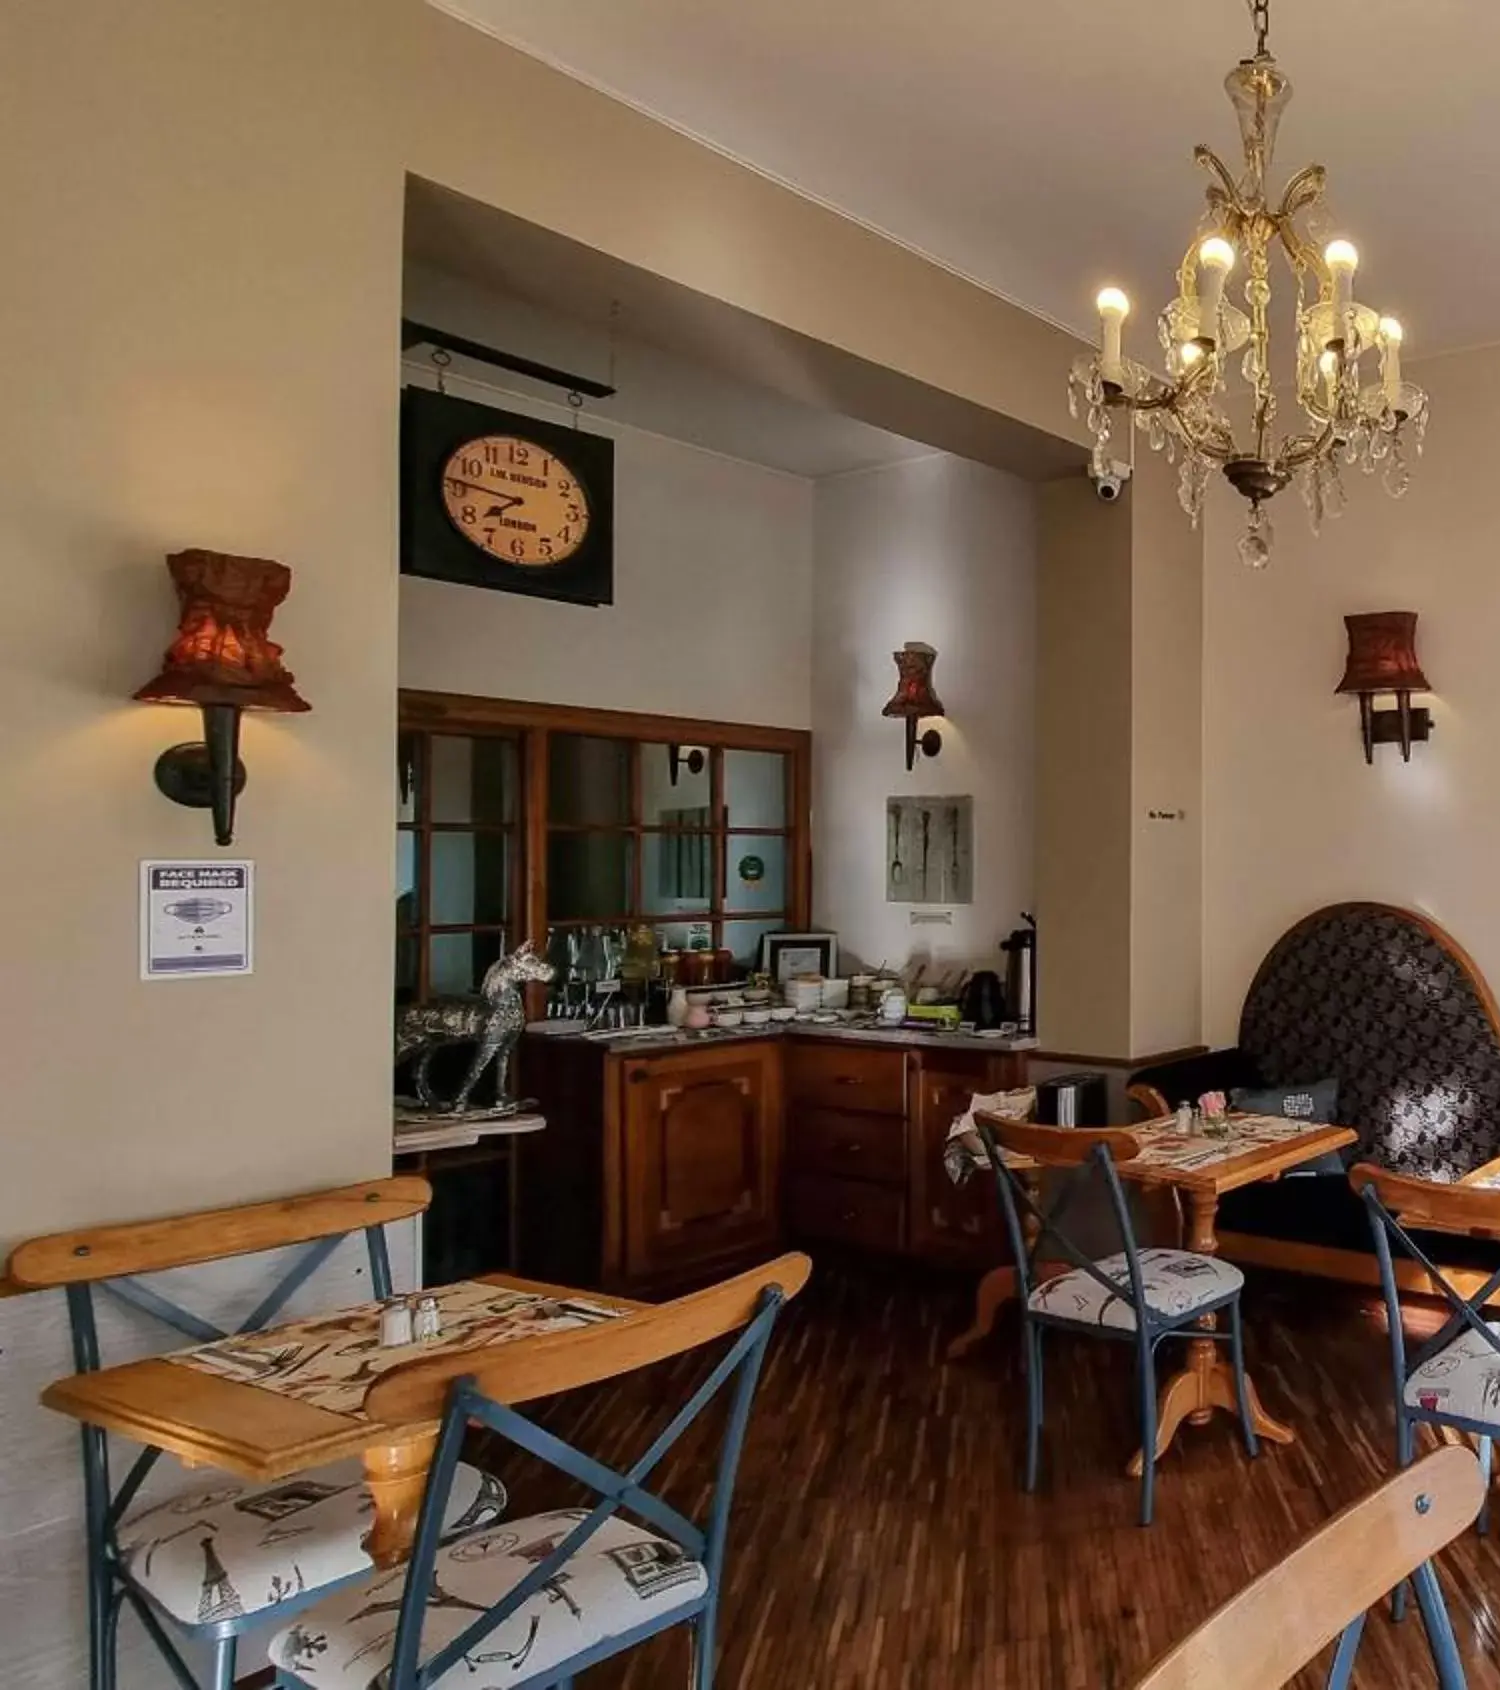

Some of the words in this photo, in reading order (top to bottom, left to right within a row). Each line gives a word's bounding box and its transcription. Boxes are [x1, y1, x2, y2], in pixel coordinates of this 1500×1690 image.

[485, 445, 498, 465] 11
[508, 443, 529, 466] 12
[461, 457, 483, 478] 10
[542, 459, 549, 477] 1
[557, 479, 571, 498] 2
[461, 505, 477, 524] 8
[565, 503, 579, 523] 3
[483, 527, 496, 545] 7
[557, 525, 570, 544] 4
[510, 538, 525, 557] 6
[539, 537, 553, 555] 5
[159, 879, 238, 888] REQUIRED
